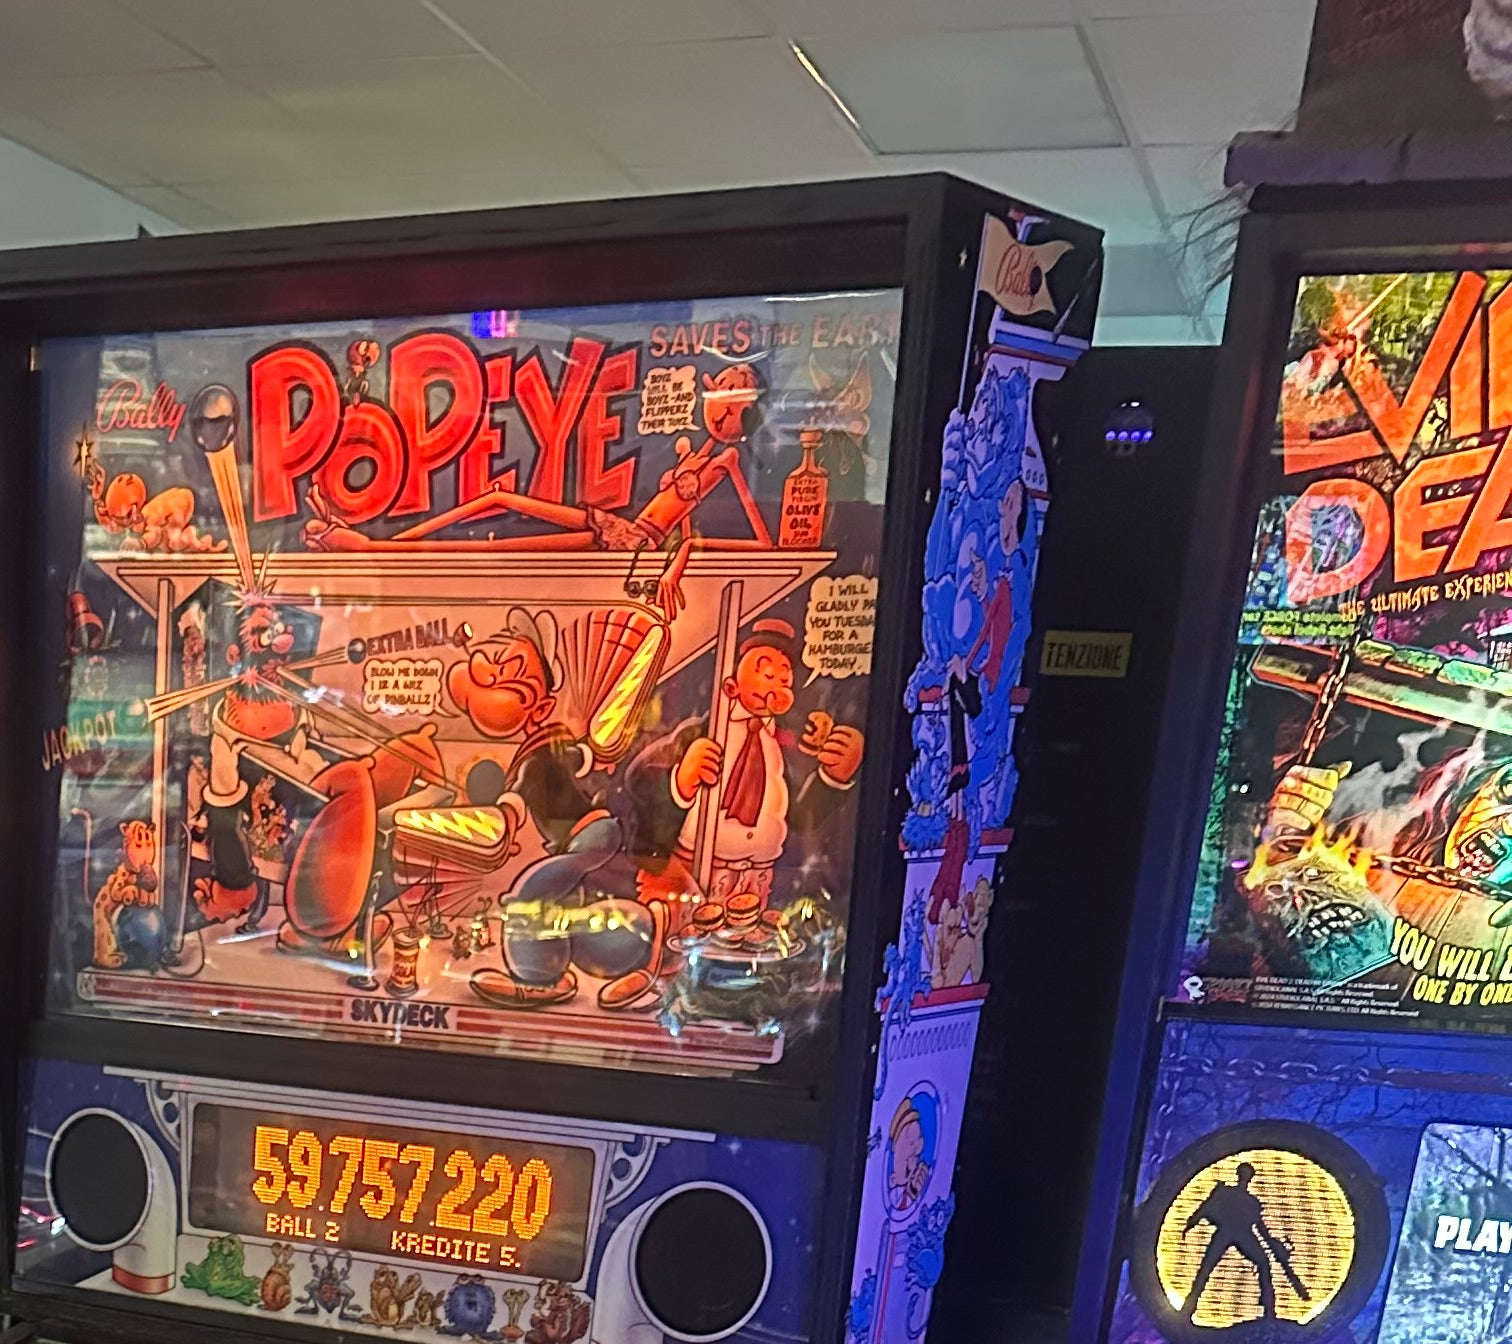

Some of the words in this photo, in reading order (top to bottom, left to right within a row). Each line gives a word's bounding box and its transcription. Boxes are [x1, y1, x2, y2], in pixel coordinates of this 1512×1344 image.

[650, 318, 752, 358] SAVES
[759, 322, 802, 346] THE
[96, 379, 187, 442] Bally
[250, 327, 640, 525] POPEYE
[785, 503, 822, 516] OLIVE
[789, 516, 812, 530] OIL
[828, 583, 834, 597] I
[838, 583, 869, 596] WILL
[1340, 602, 1365, 622] THE
[1369, 585, 1440, 613] ULTIMATE
[808, 616, 832, 629] YOU
[815, 600, 859, 613] GLADLY
[367, 629, 415, 657] EXTRA
[414, 617, 448, 649] BALL
[822, 630, 845, 642] FOR
[849, 629, 859, 641] A
[370, 667, 395, 677] BLOW
[398, 667, 411, 678] ME
[392, 680, 401, 690] A
[42, 709, 117, 772] JACKPOT
[1390, 916, 1436, 971] YOU
[1437, 944, 1494, 981] WILL
[1412, 975, 1449, 1004] ONE
[1449, 981, 1479, 1006] BY
[350, 998, 451, 1031] SKYDECK
[252, 1125, 553, 1241] 59.757.220
[265, 1212, 317, 1239] BALL
[324, 1221, 340, 1242] 2
[390, 1230, 490, 1264] KREDITE
